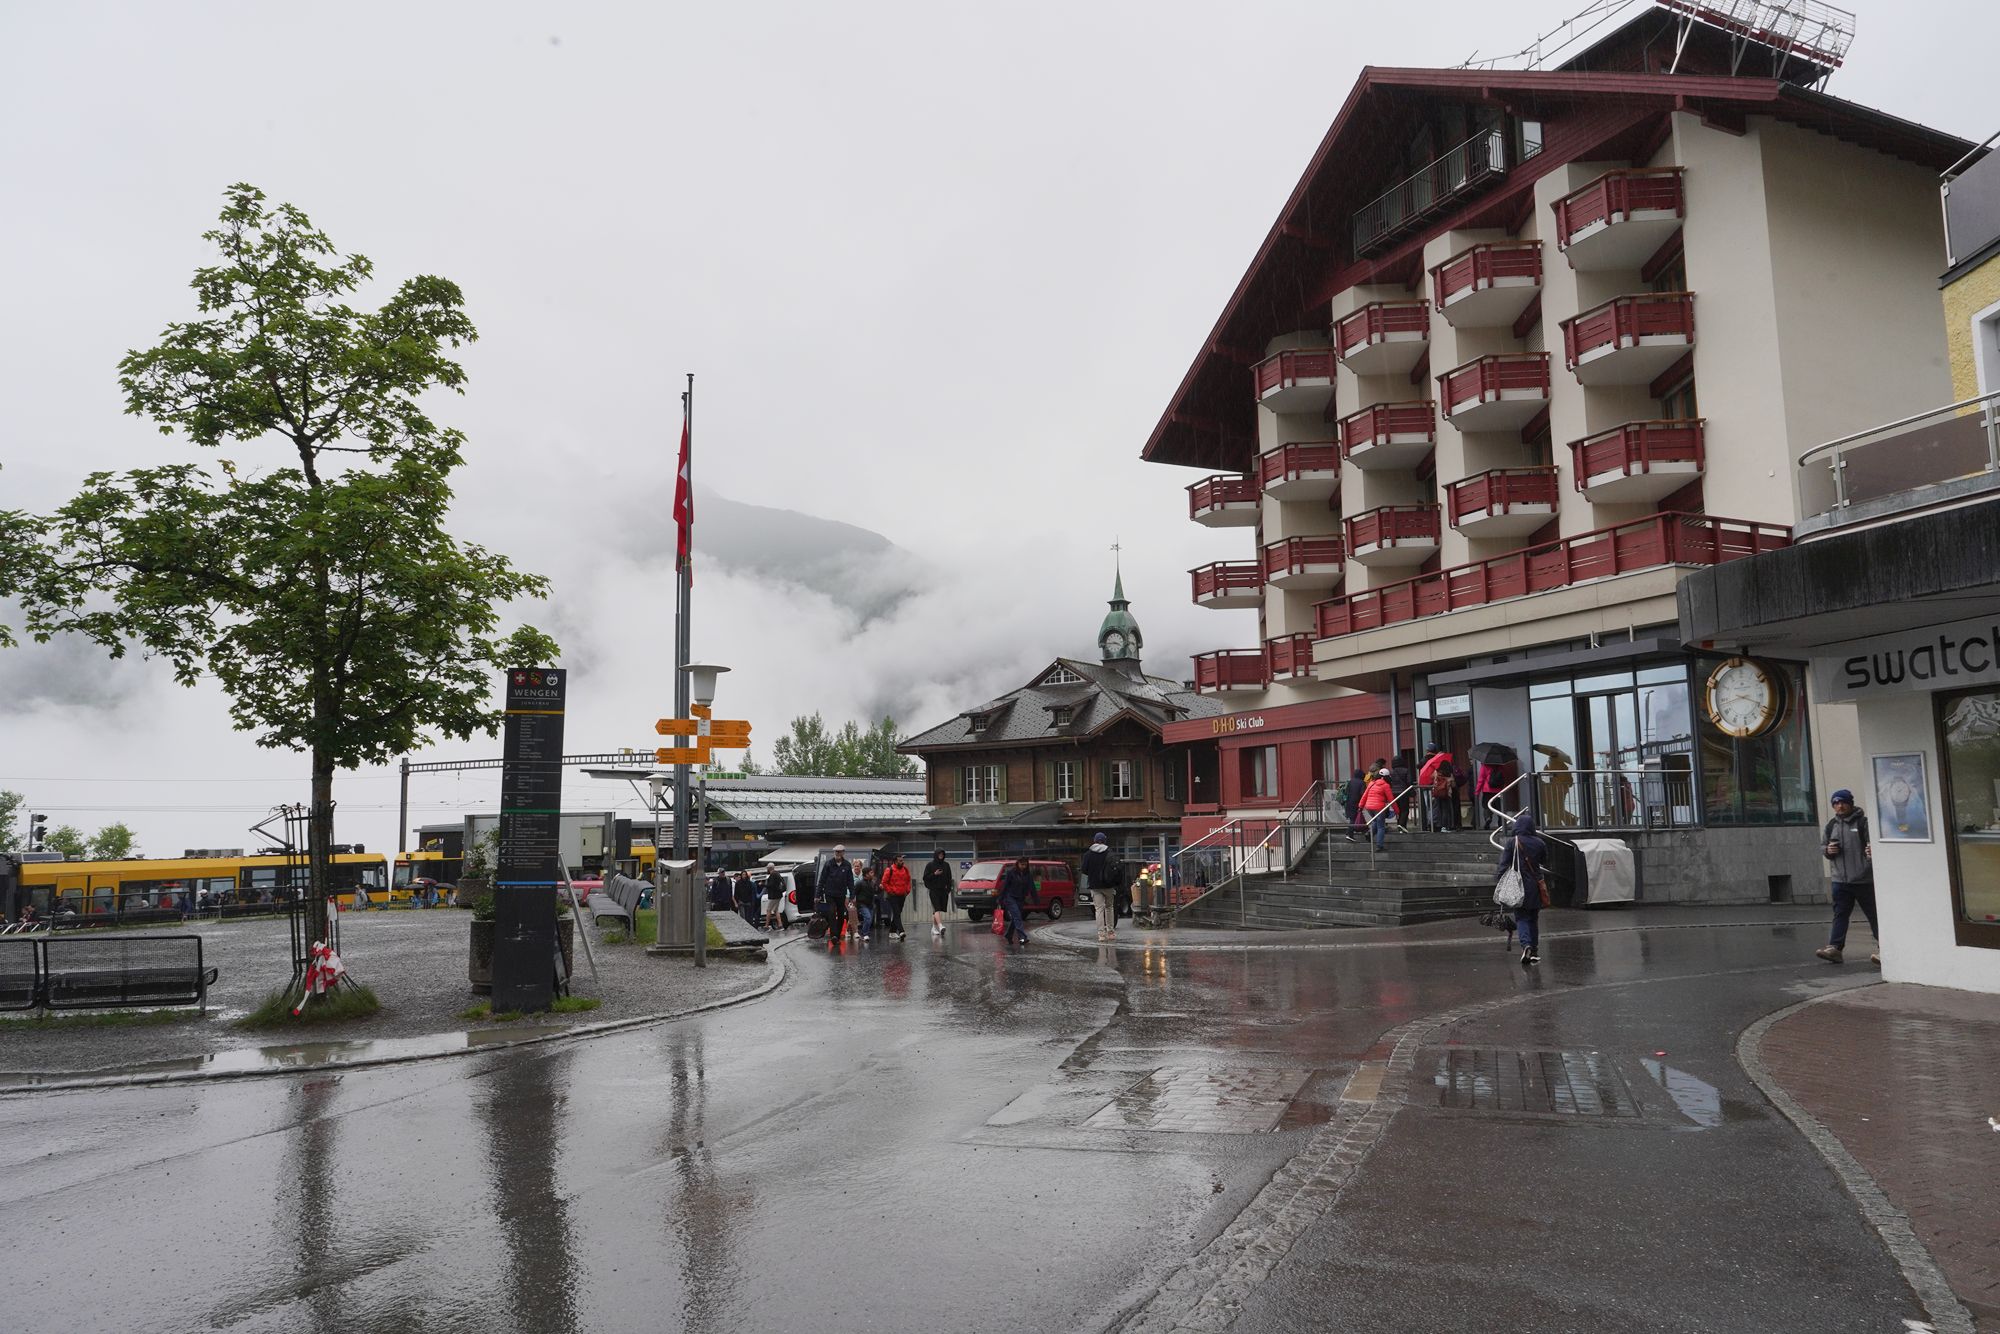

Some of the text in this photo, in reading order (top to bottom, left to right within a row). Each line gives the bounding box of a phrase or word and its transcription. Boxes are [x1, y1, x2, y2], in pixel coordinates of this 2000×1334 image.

[514, 689, 558, 697] WENGEN
[1236, 718, 1247, 730] Ski
[1248, 716, 1264, 728] Club
